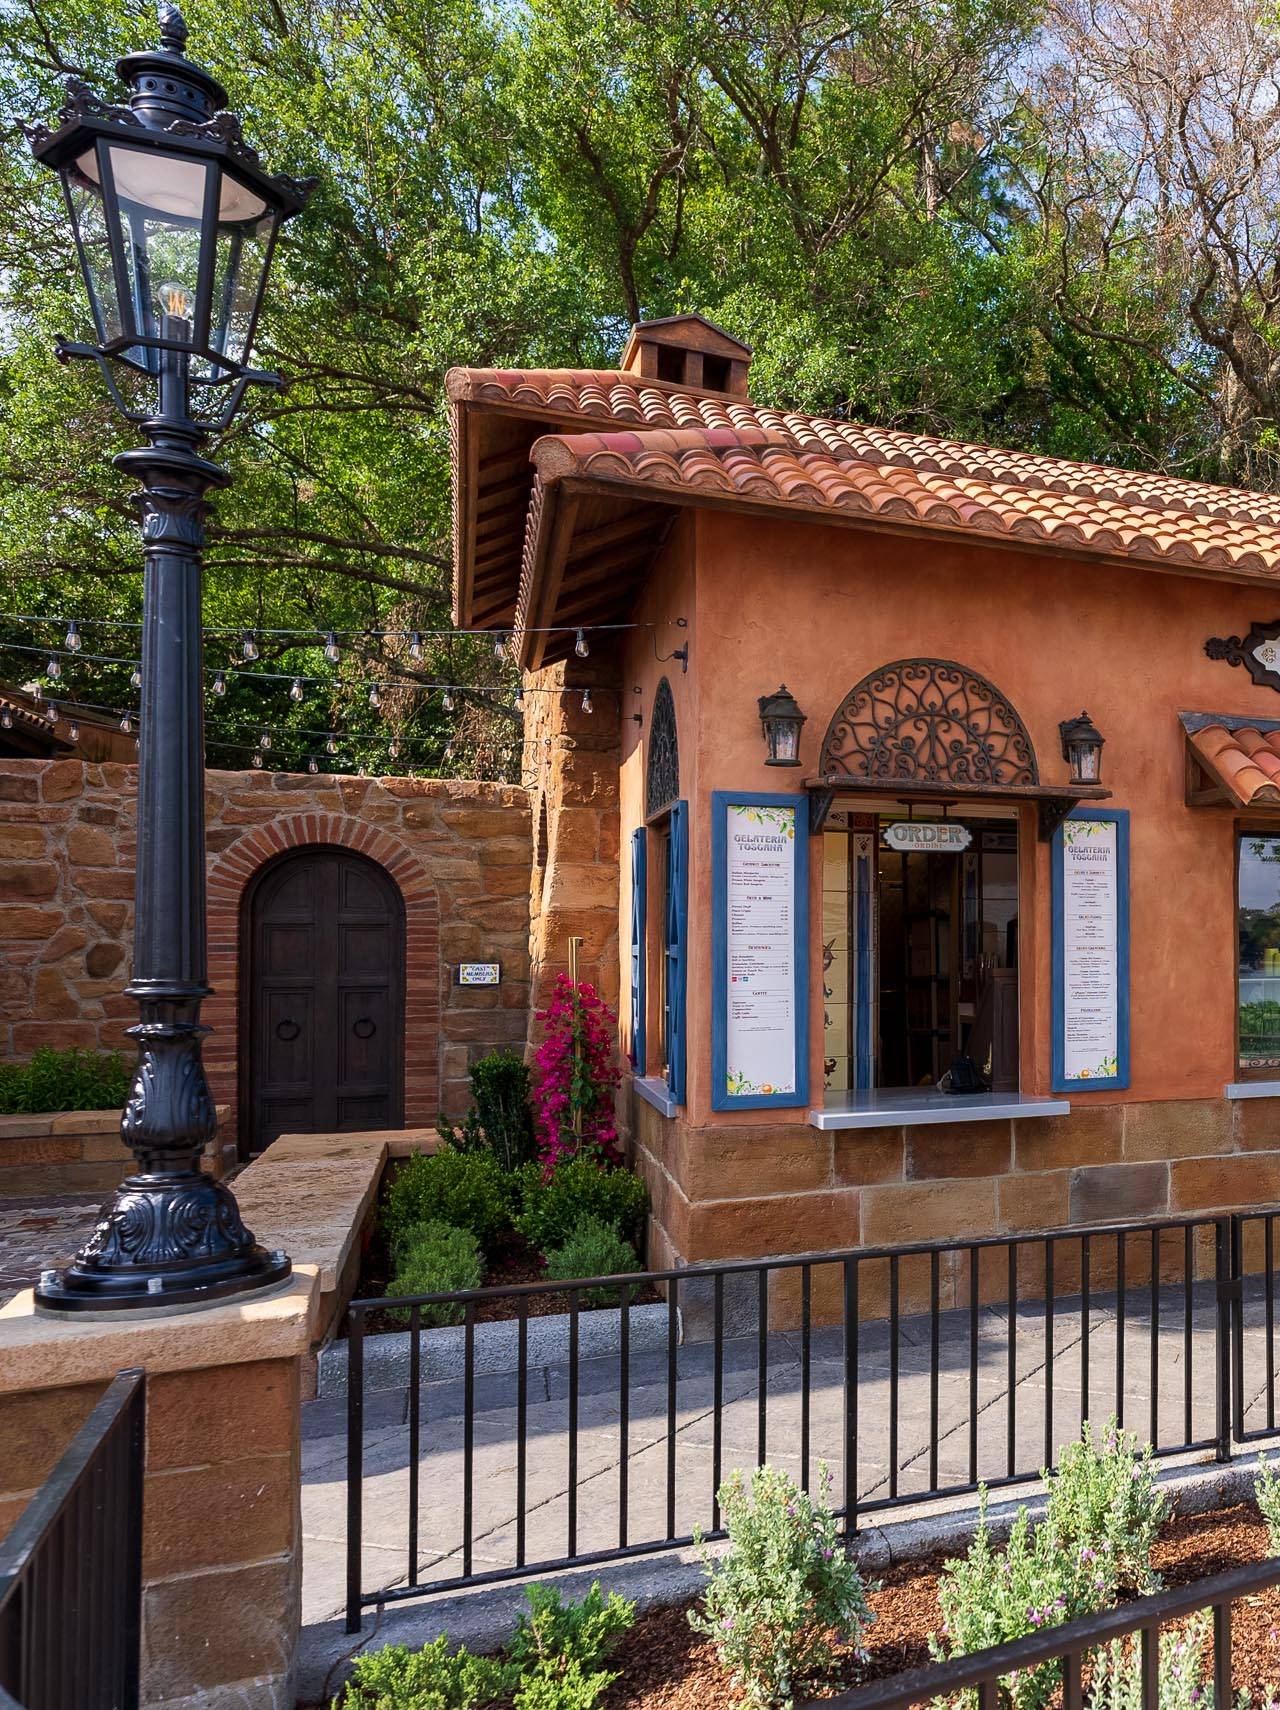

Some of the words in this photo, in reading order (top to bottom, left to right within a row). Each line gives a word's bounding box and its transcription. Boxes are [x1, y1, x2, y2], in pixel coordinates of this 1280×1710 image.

[734, 834, 787, 843] GELATERIA
[893, 825, 962, 844] ORDER
[737, 843, 783, 852] TOSCANA
[1067, 845, 1111, 854] GELATERIA
